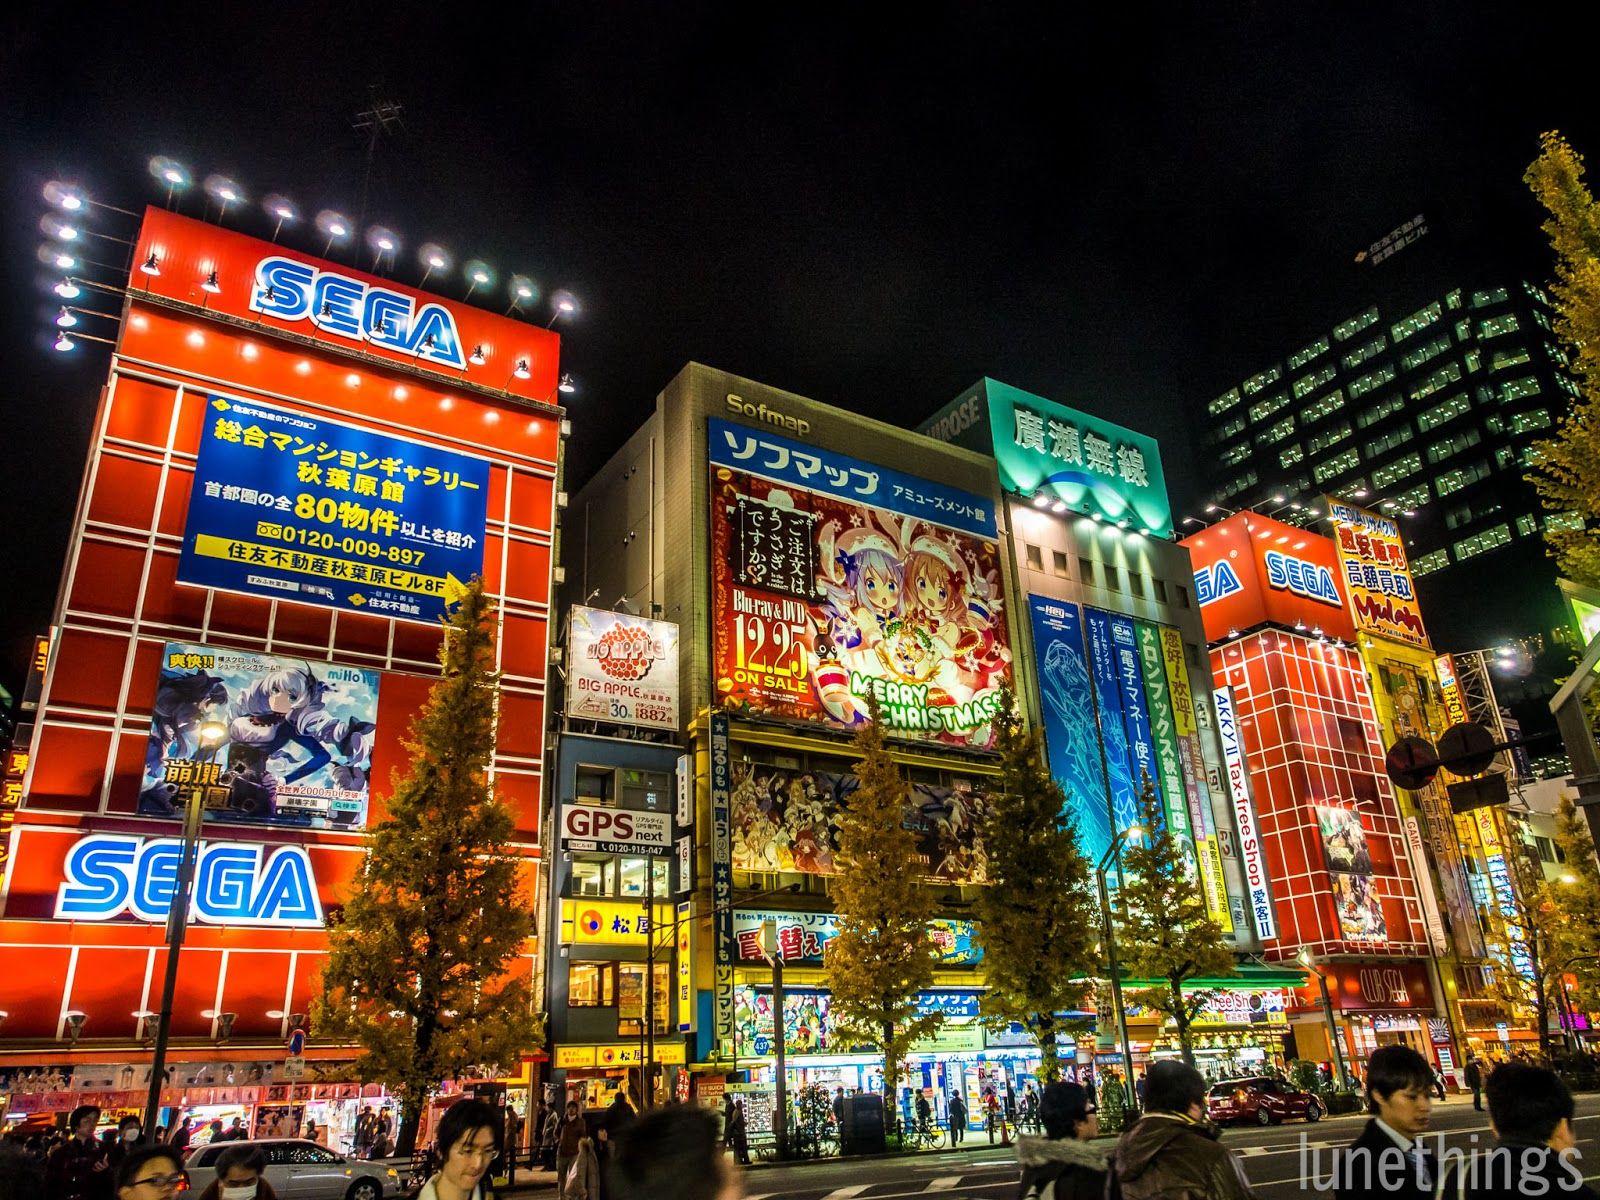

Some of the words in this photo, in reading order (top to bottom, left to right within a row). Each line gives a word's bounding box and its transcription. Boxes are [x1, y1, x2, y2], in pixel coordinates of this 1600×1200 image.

[249, 256, 468, 370] SEGA
[726, 394, 810, 436] Sofmap
[214, 418, 480, 490] 総合マンションギャラリー
[1014, 408, 1149, 487] 廣瀬無線
[297, 461, 405, 503] 秋葉原館
[724, 430, 879, 495] ソフマップ
[893, 484, 986, 522] アミューズメント館
[282, 526, 425, 566] 0120-009-897
[769, 507, 786, 571] うさぎ
[788, 518, 806, 595] ご注文は
[228, 542, 445, 592] 住友不動産秋葉原ビル8F
[1265, 550, 1343, 607] SEGA
[1345, 559, 1413, 599] 高額買取
[368, 597, 420, 615] 住友不動産
[733, 589, 774, 623] Blu-ray
[782, 599, 805, 626] DVD
[169, 653, 215, 669] 爽快!!
[587, 642, 610, 659] BIG
[612, 640, 665, 660] APPLE
[733, 613, 808, 681] 12.25
[578, 678, 601, 692] BIG
[734, 670, 759, 686] ON
[764, 675, 808, 694] SALE
[851, 671, 929, 708] MERRY
[610, 703, 628, 719] 30
[1119, 649, 1151, 778] 電子マネー使
[1215, 694, 1237, 744] AKKY
[1229, 758, 1251, 836] Tax-free
[1244, 839, 1262, 887] Shop
[567, 809, 633, 839] GPS
[636, 816, 664, 825] リアルタイム
[636, 832, 663, 841] next
[1406, 821, 1422, 851] GAME
[609, 843, 663, 855] 0120-915-047
[53, 834, 326, 927] SEGA
[612, 915, 649, 934] 松屋
[715, 881, 730, 961] サポートも
[717, 968, 732, 1036] ソフマップ
[1360, 969, 1384, 1003] CLUB
[1384, 969, 1409, 1003] SEGA
[755, 1042, 767, 1050] 437
